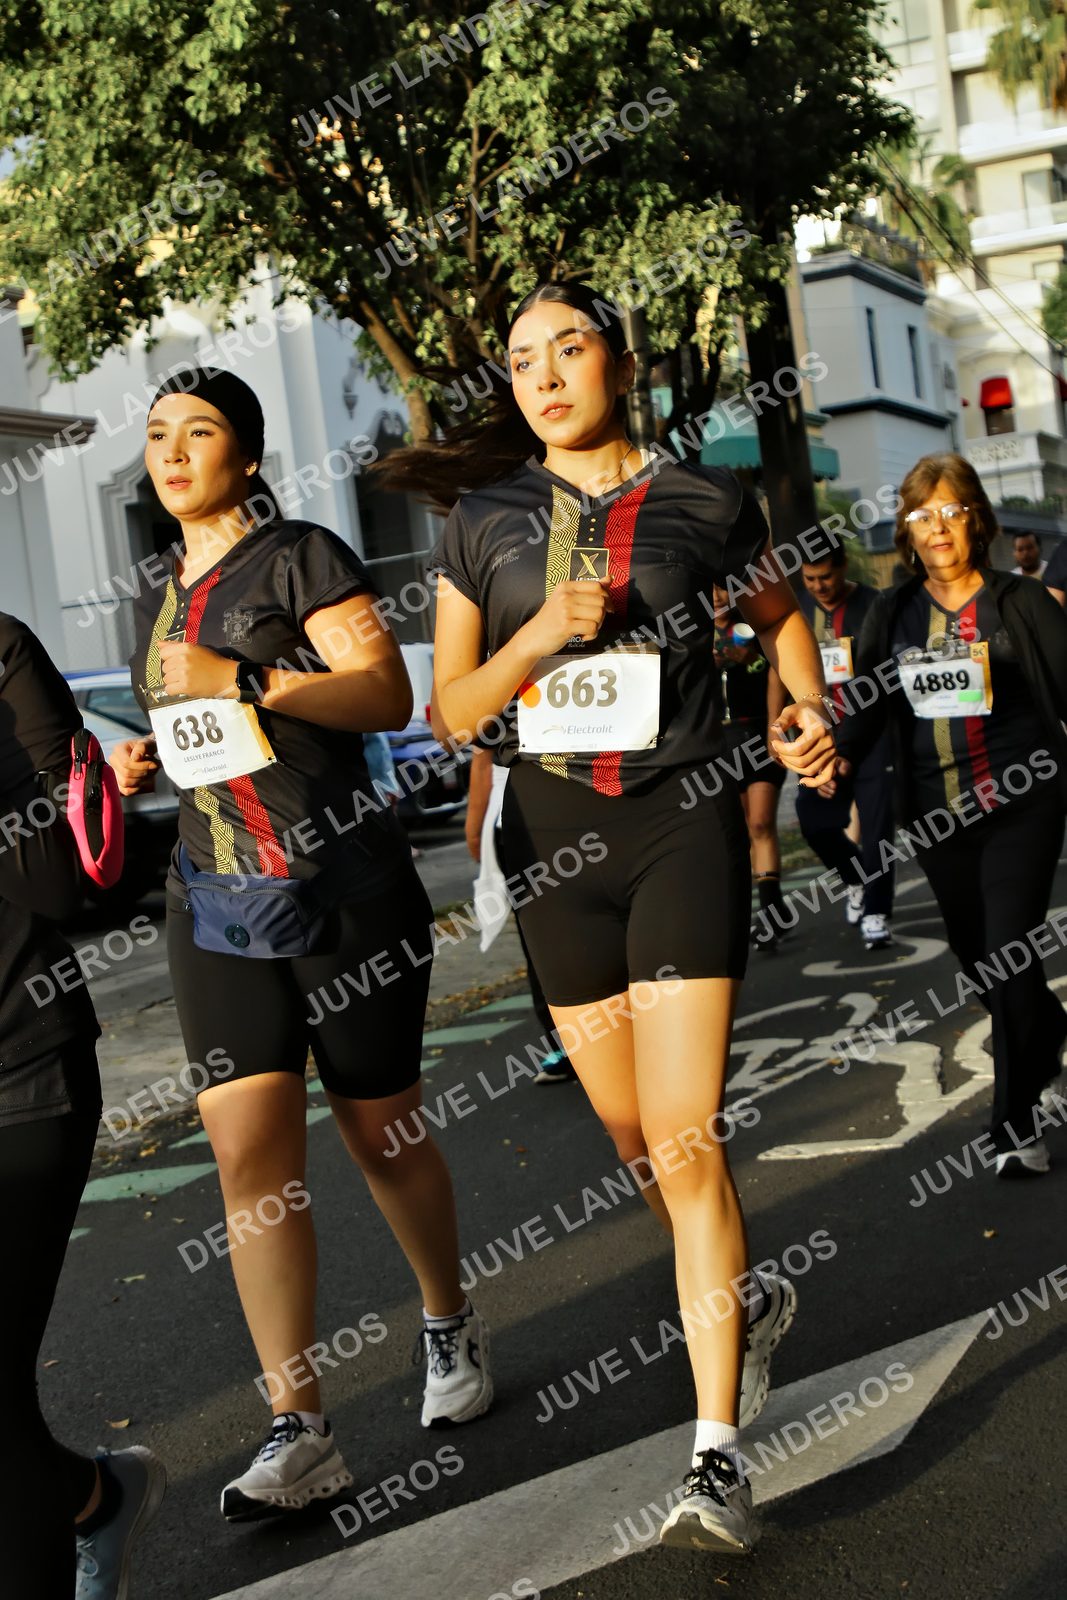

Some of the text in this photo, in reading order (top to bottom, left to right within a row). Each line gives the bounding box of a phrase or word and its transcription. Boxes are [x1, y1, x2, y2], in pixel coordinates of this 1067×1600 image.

[546, 668, 618, 709] 663
[913, 669, 970, 695] 4889
[172, 710, 224, 751] 638
[566, 725, 613, 735] Electrolit
[202, 749, 225, 759] FRANCO
